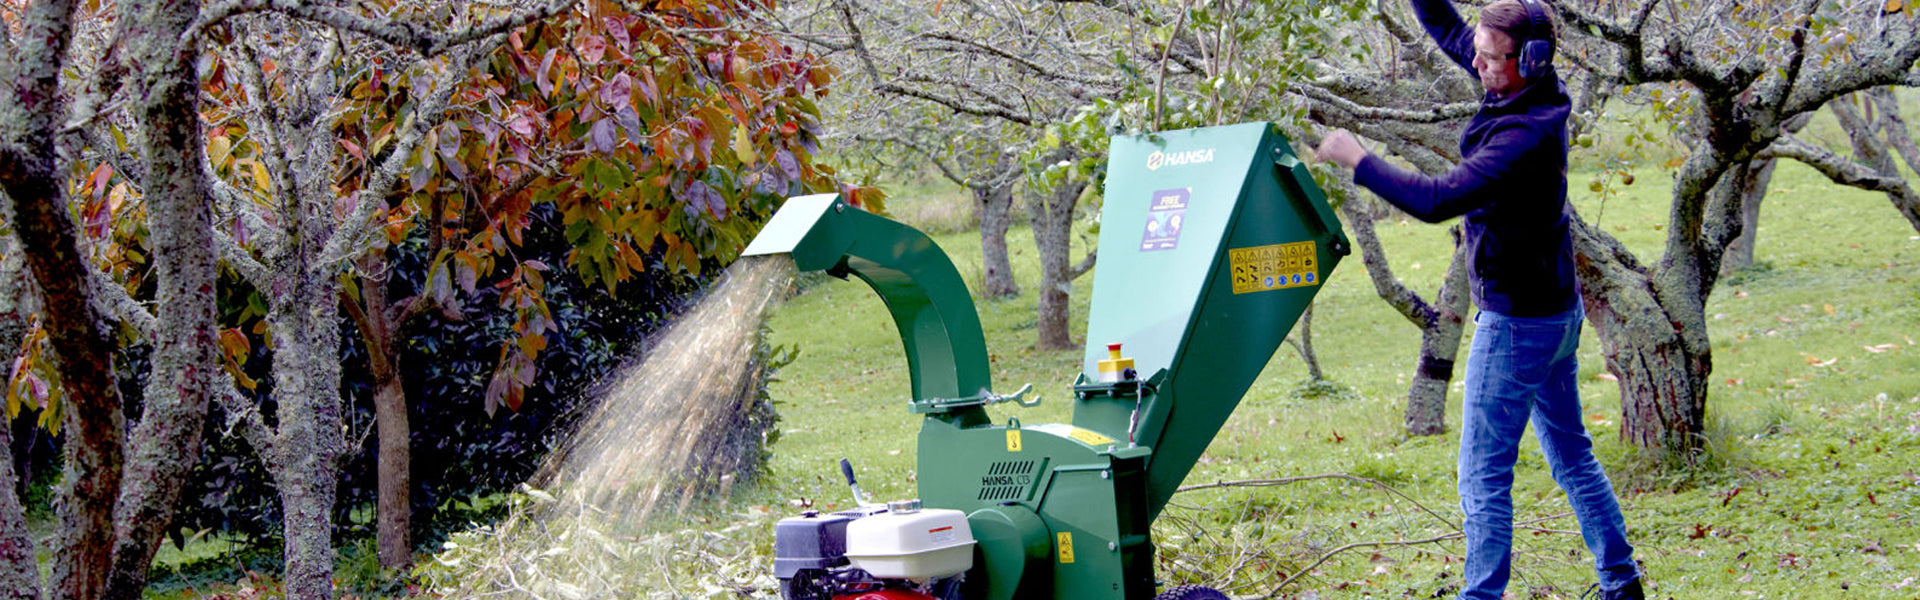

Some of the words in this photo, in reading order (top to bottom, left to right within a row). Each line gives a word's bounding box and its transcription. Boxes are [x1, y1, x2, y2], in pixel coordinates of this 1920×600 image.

[1165, 149, 1214, 166] HANSA
[1160, 195, 1180, 206] FREE
[982, 476, 1014, 486] HANSA
